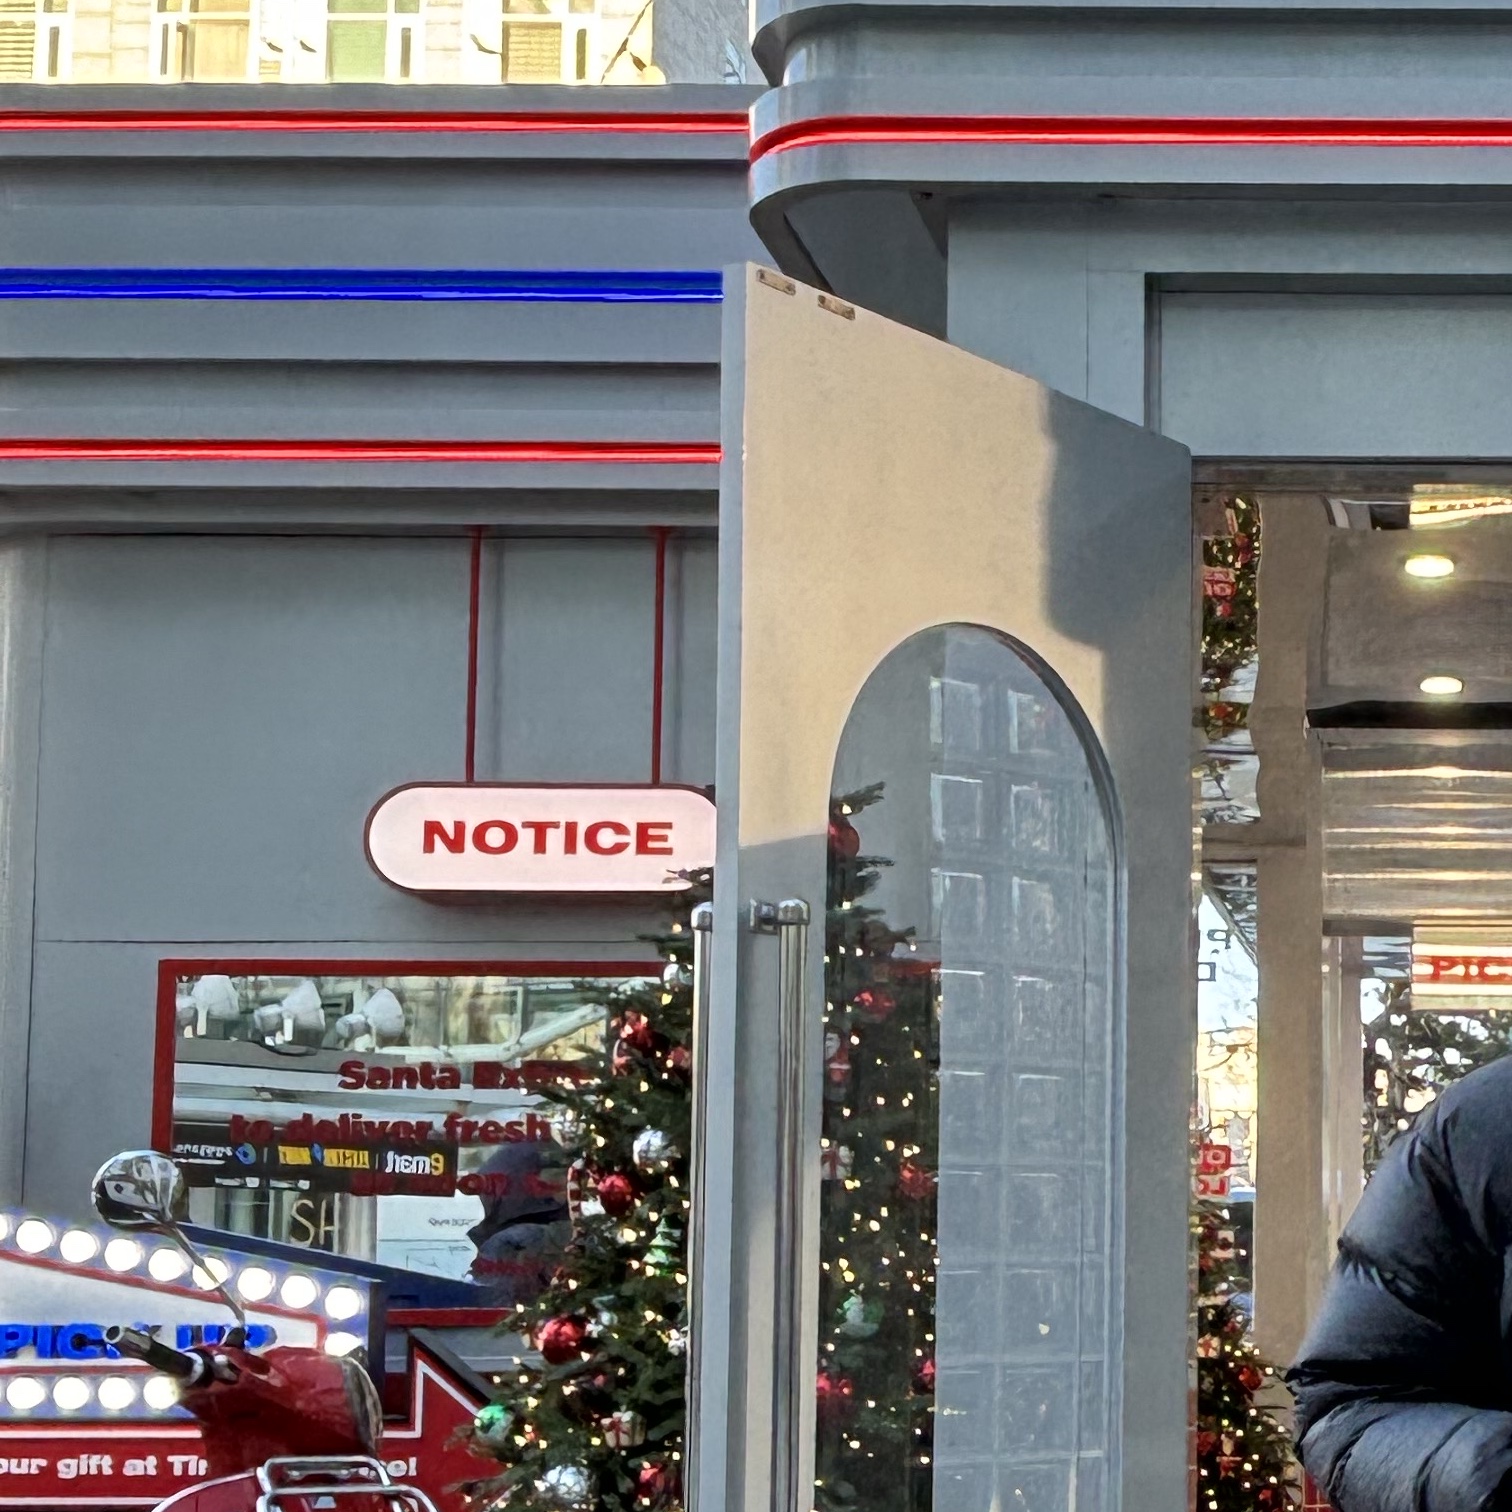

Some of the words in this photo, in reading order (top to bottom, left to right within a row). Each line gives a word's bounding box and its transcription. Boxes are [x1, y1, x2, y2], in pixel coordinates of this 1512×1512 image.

[422, 819, 674, 856] NOTICE
[338, 1060, 461, 1090] Santa
[230, 1113, 275, 1146] to
[284, 1112, 433, 1146] deliver
[444, 1111, 551, 1145] fresh
[56, 1453, 114, 1480] gift
[122, 1454, 158, 1477] at
